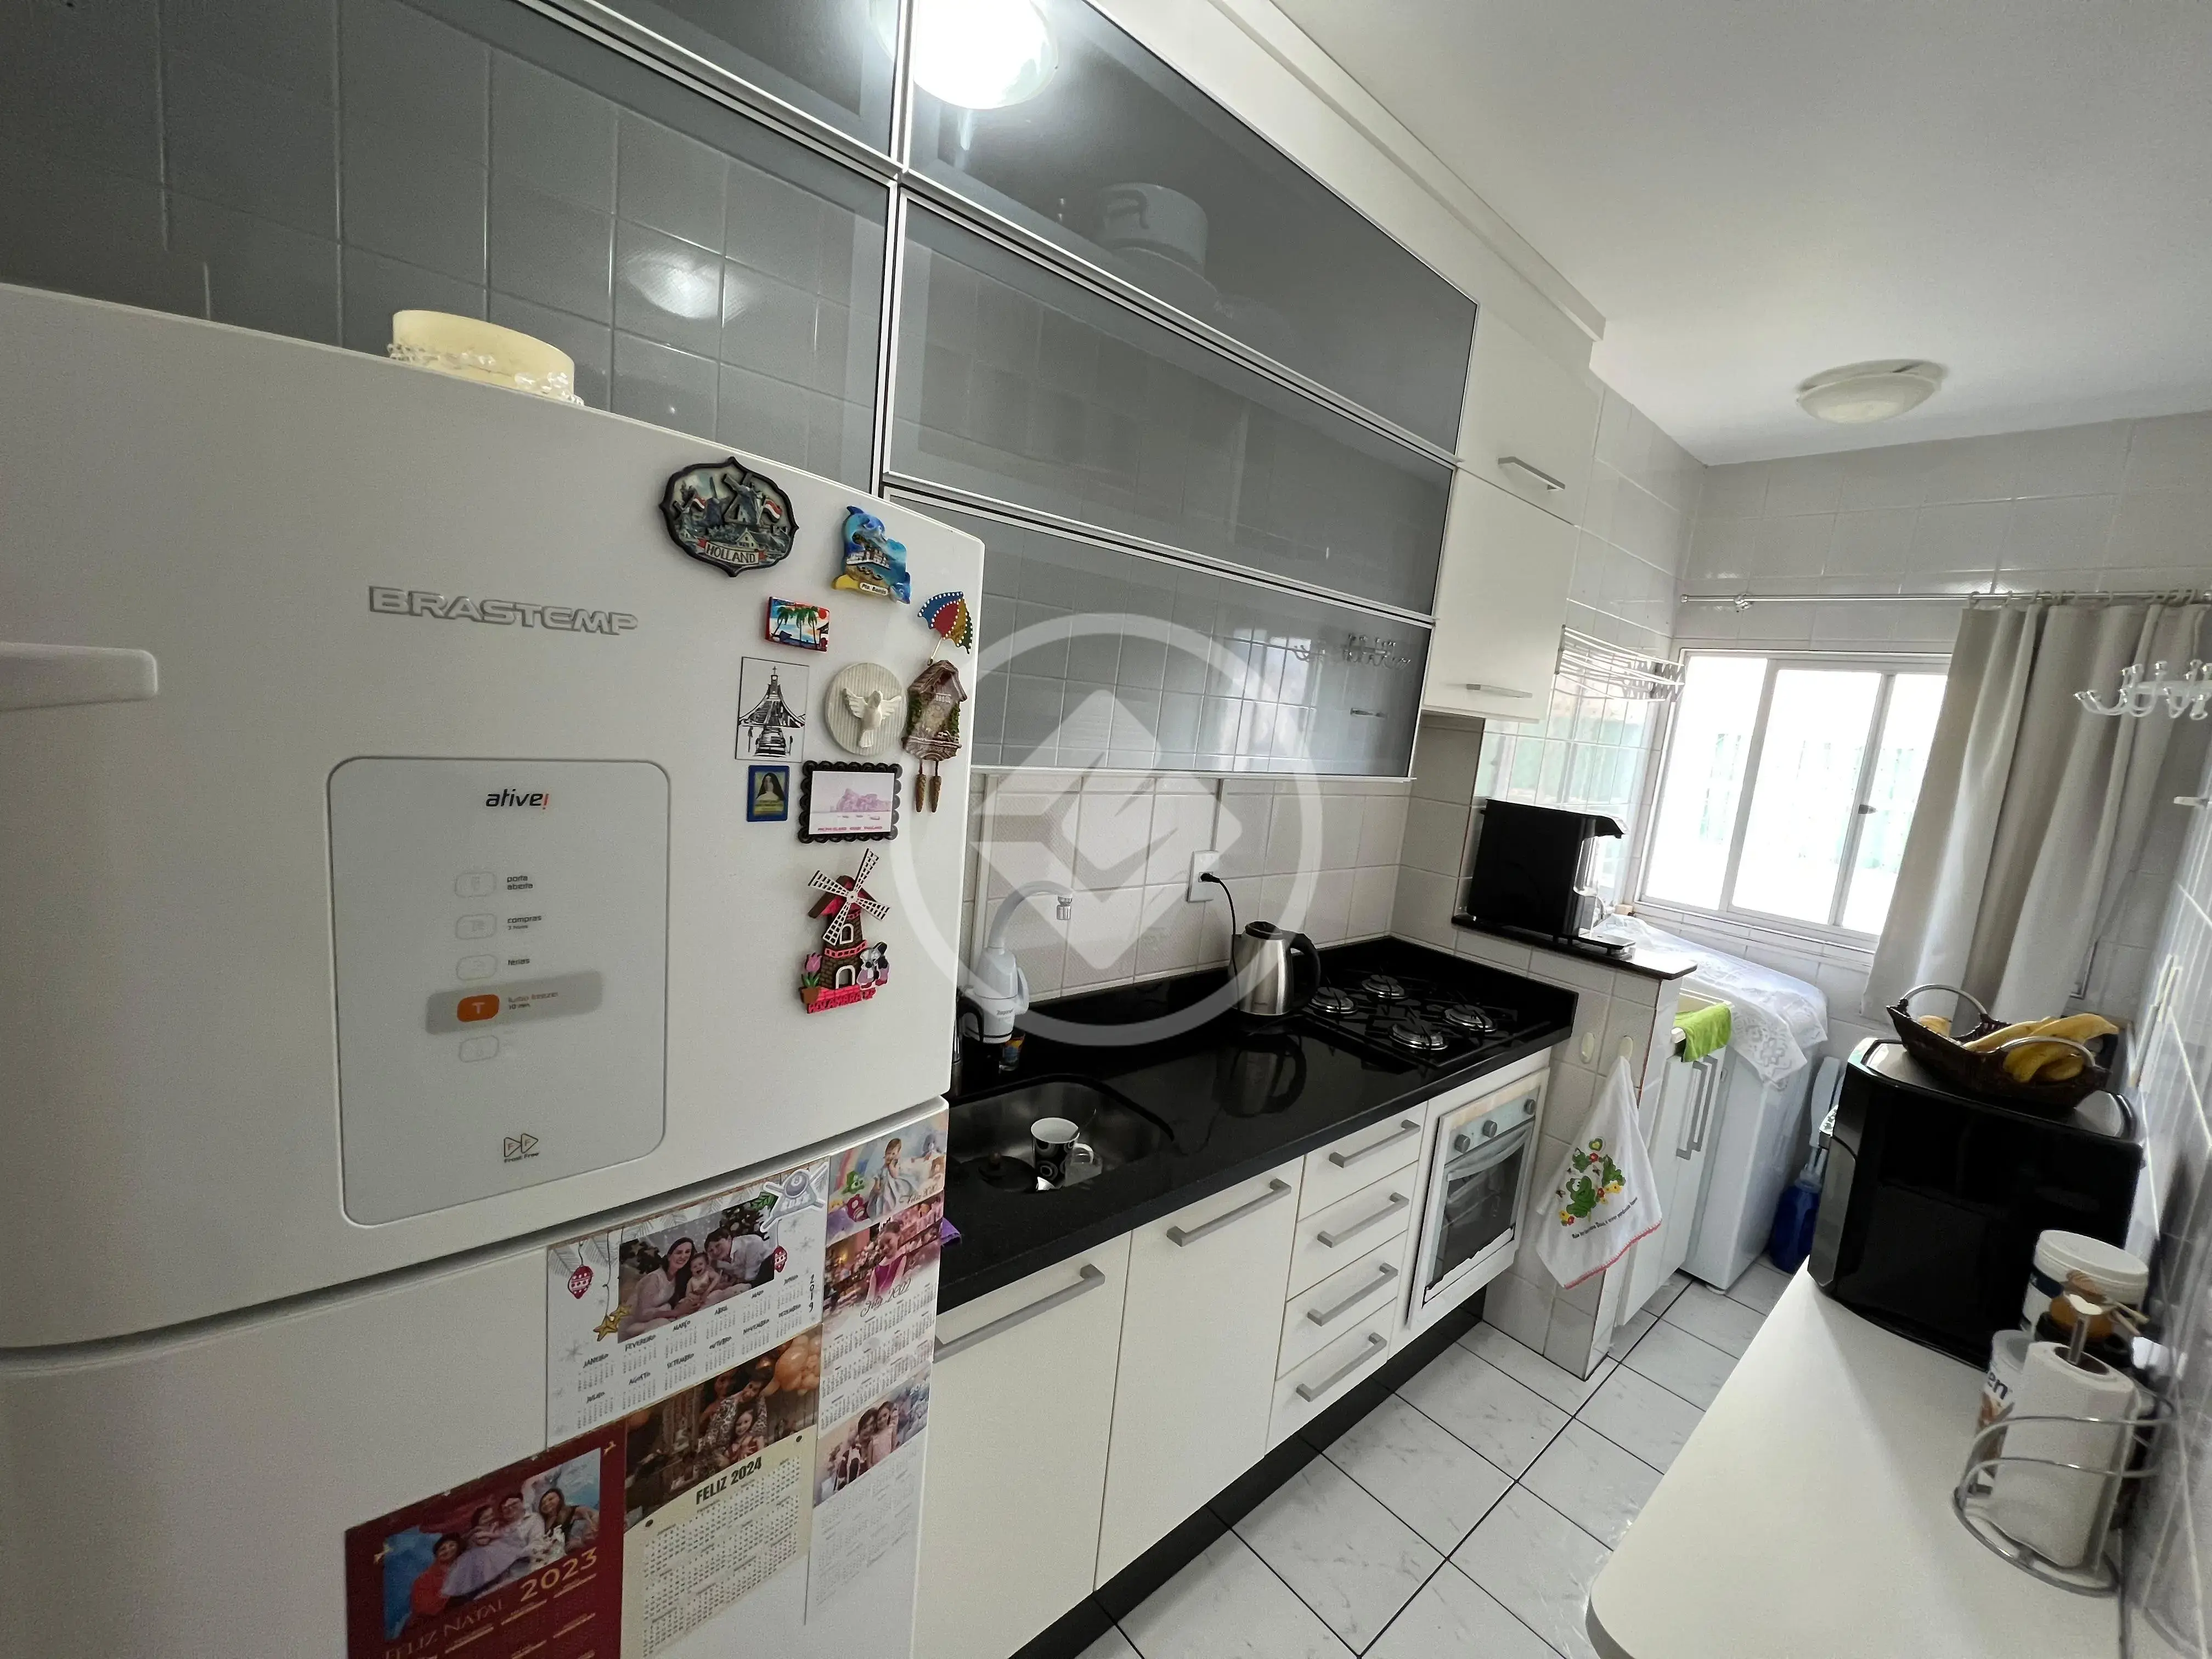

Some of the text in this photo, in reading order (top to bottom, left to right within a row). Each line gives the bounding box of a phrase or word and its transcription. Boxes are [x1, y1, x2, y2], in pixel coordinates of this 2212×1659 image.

[706, 543, 755, 563] HOLLAND
[369, 585, 639, 635] BRASTEMP
[507, 915, 542, 923] compras
[625, 1334, 656, 1352] FEVEREIRO
[696, 1457, 761, 1504] FELIZ 2024
[520, 1547, 597, 1602] 2023
